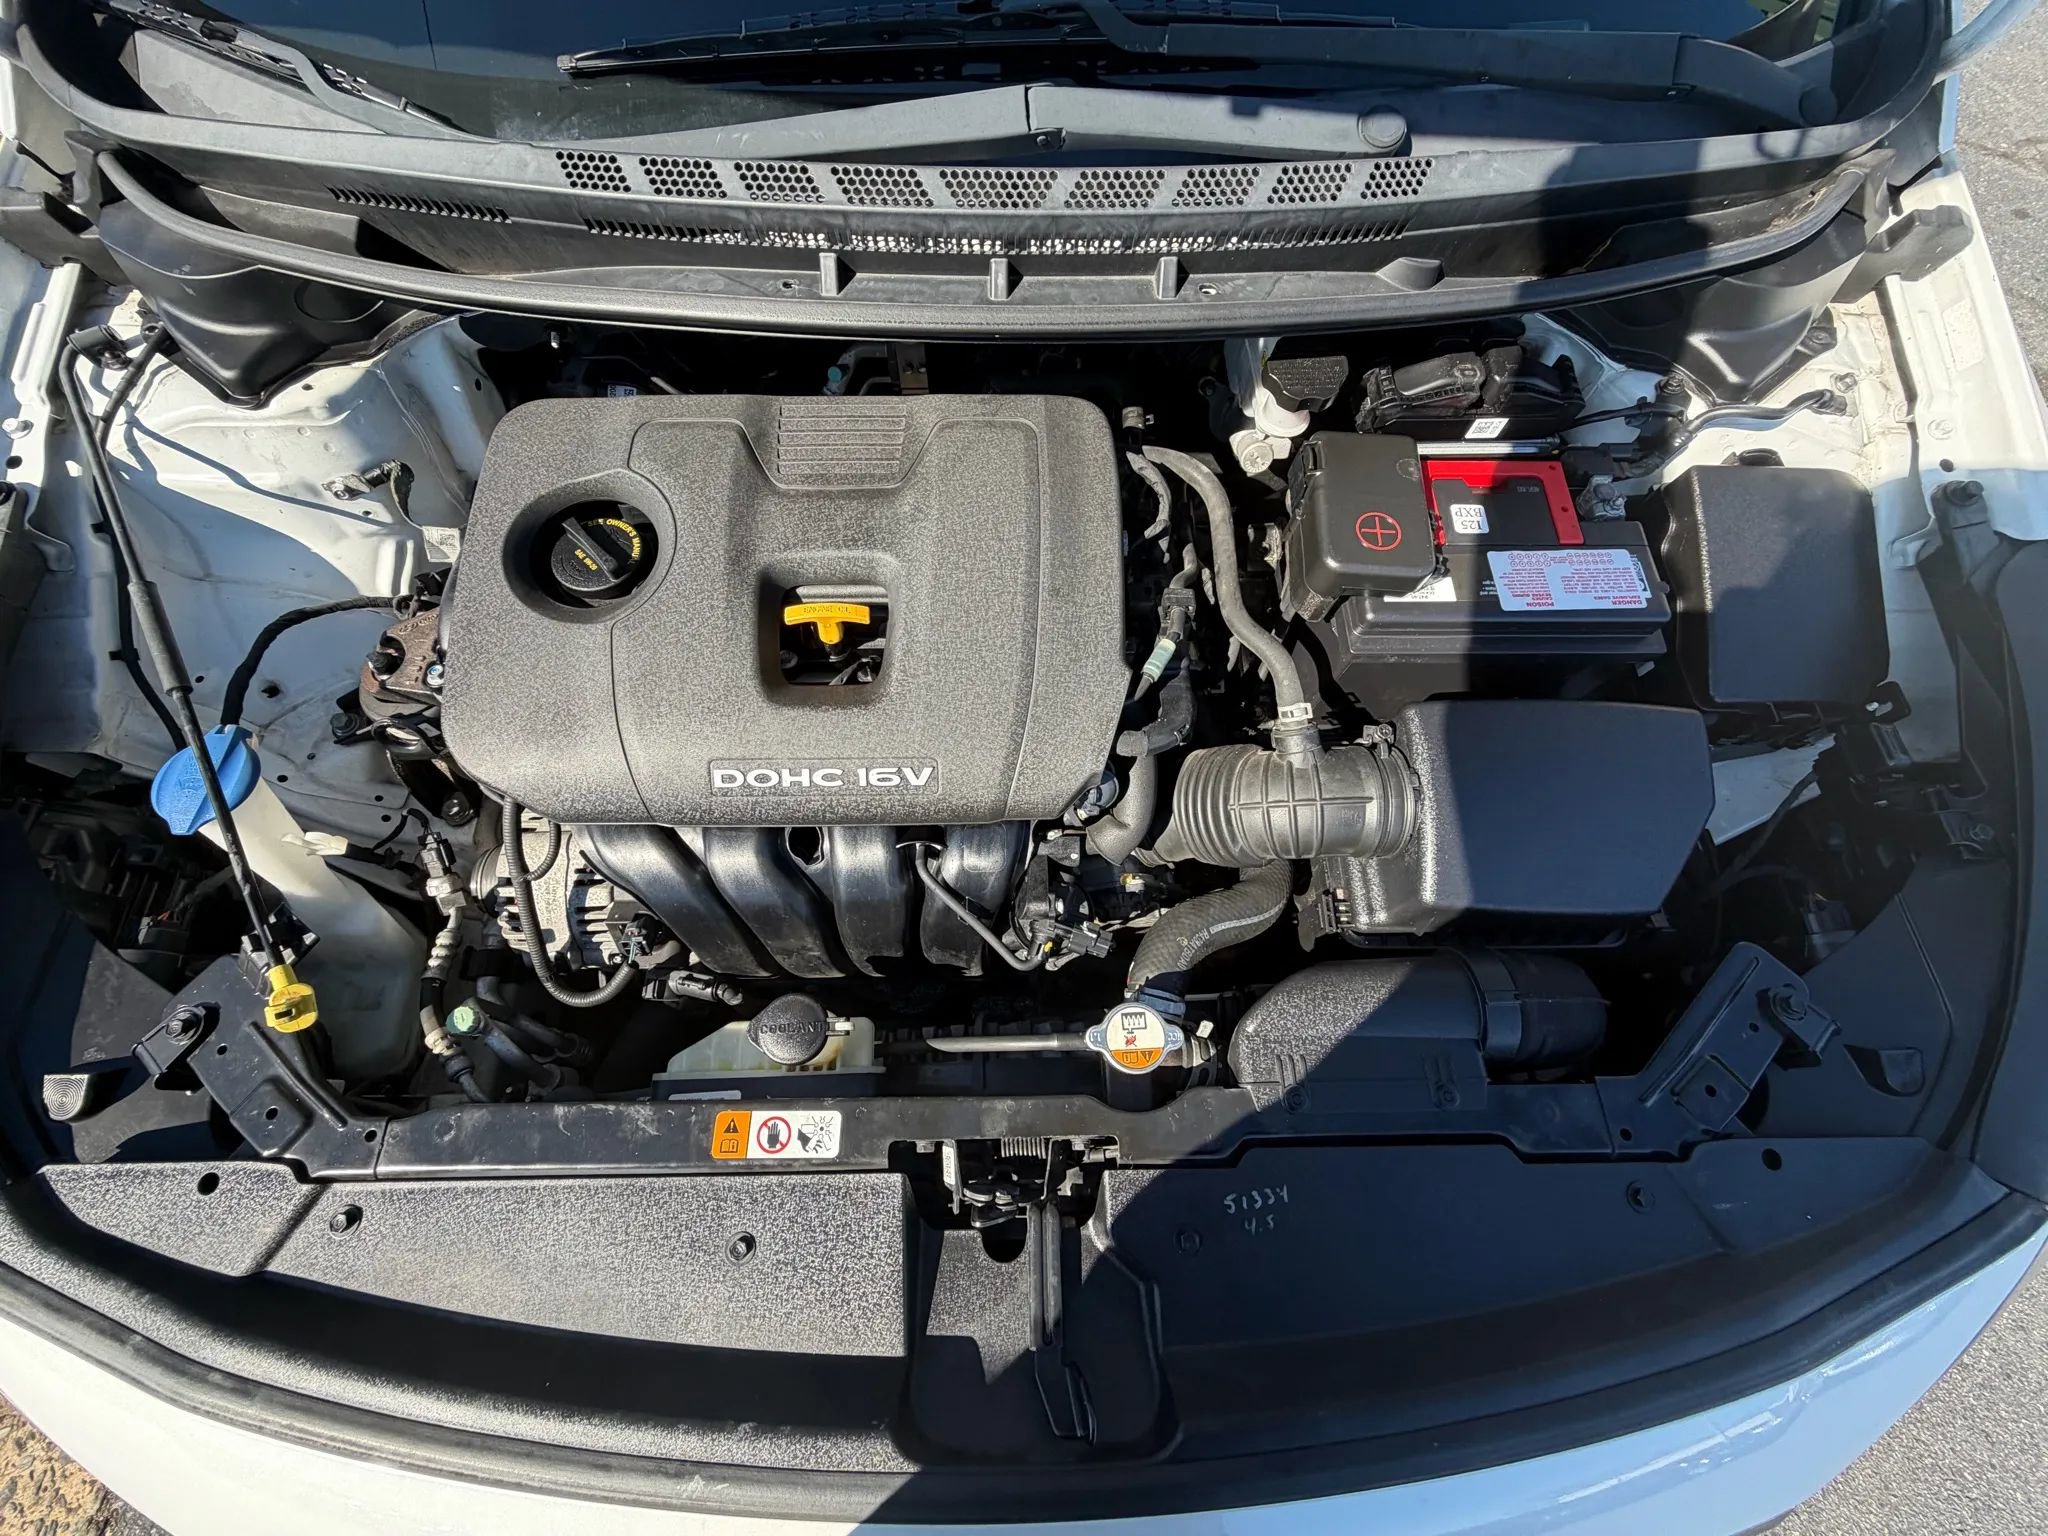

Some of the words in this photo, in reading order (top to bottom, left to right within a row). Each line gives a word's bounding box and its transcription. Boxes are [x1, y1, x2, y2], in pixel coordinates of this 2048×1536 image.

[1455, 507, 1484, 518] BXP
[606, 518, 637, 537] OWNER'S
[713, 767, 844, 787] DOHC
[857, 766, 935, 787] 16V
[760, 1021, 824, 1034] COOLANT
